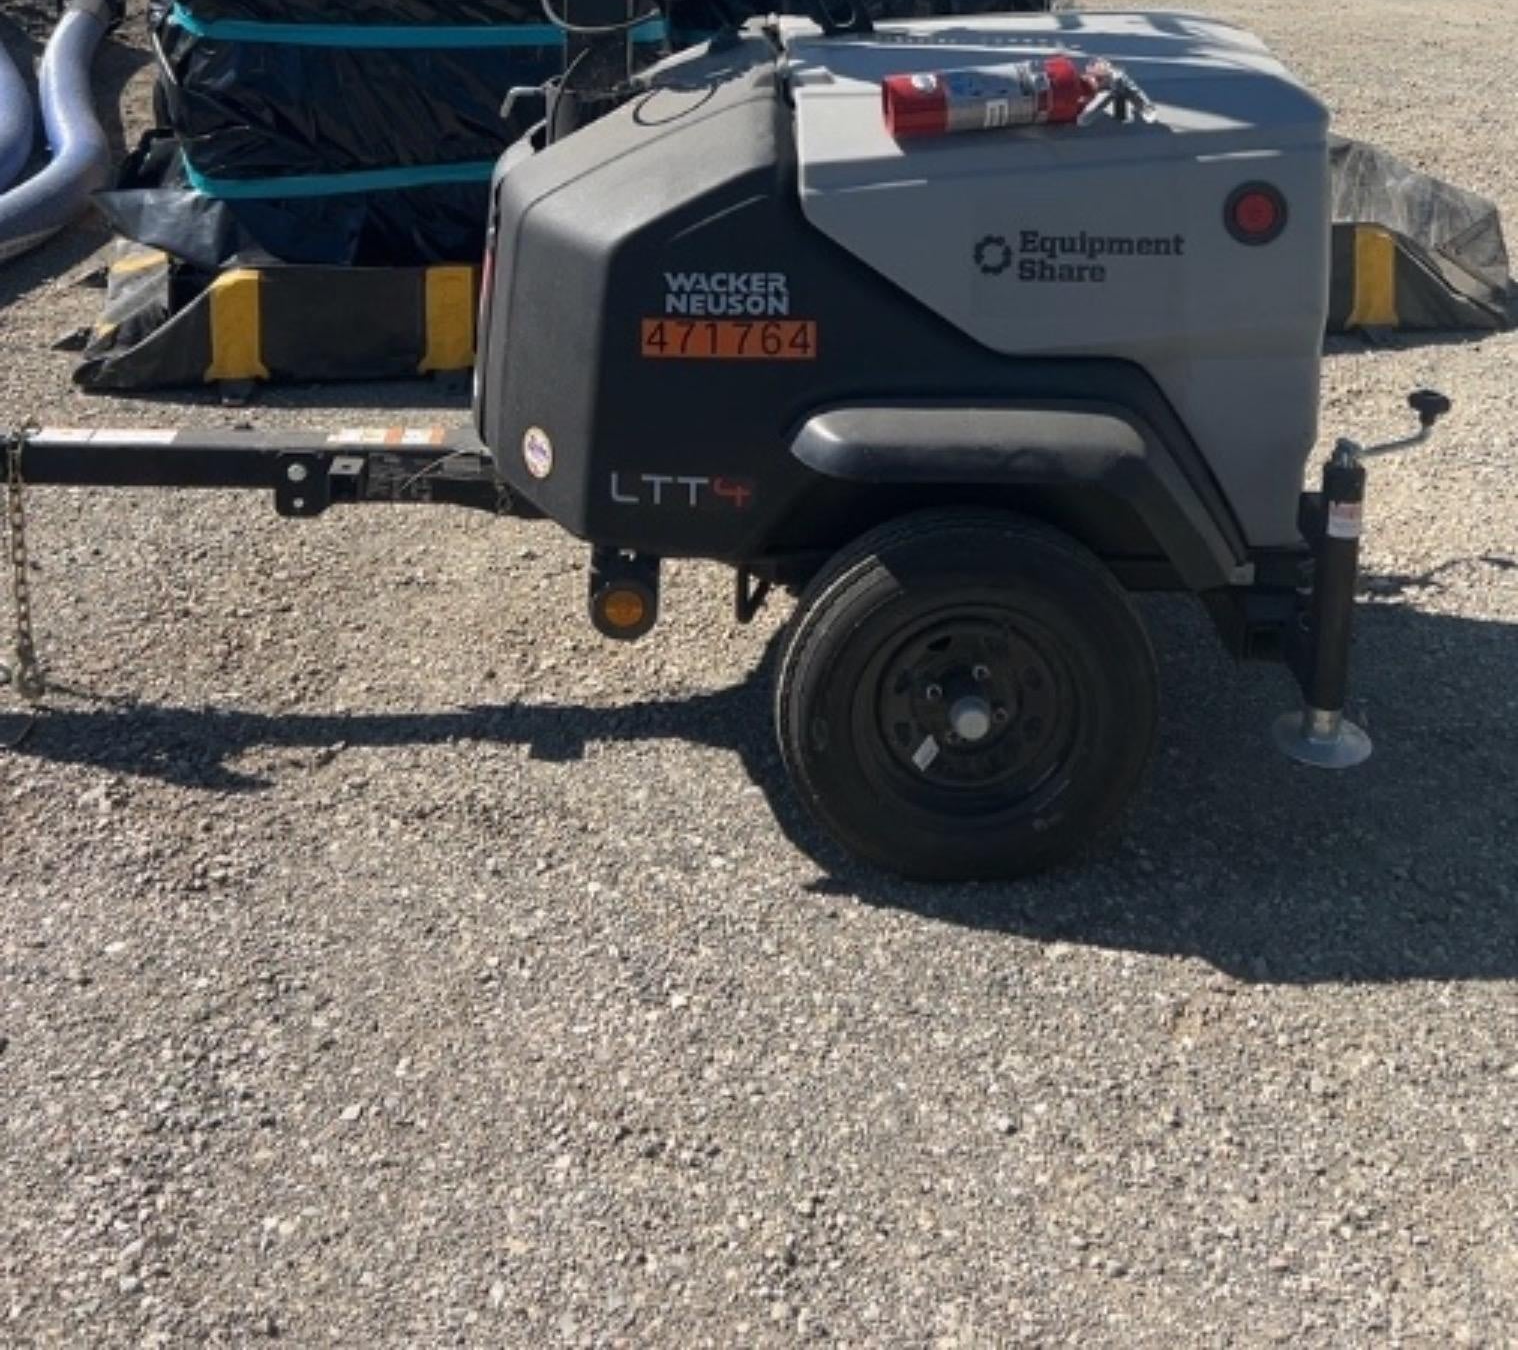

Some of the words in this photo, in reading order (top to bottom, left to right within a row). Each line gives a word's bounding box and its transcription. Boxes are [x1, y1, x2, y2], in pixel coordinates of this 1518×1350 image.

[1018, 230, 1185, 259] Equipment
[1018, 258, 1106, 282] Share
[664, 272, 788, 293] WACKER
[665, 293, 790, 315] NEUSON
[646, 321, 811, 354] 471764
